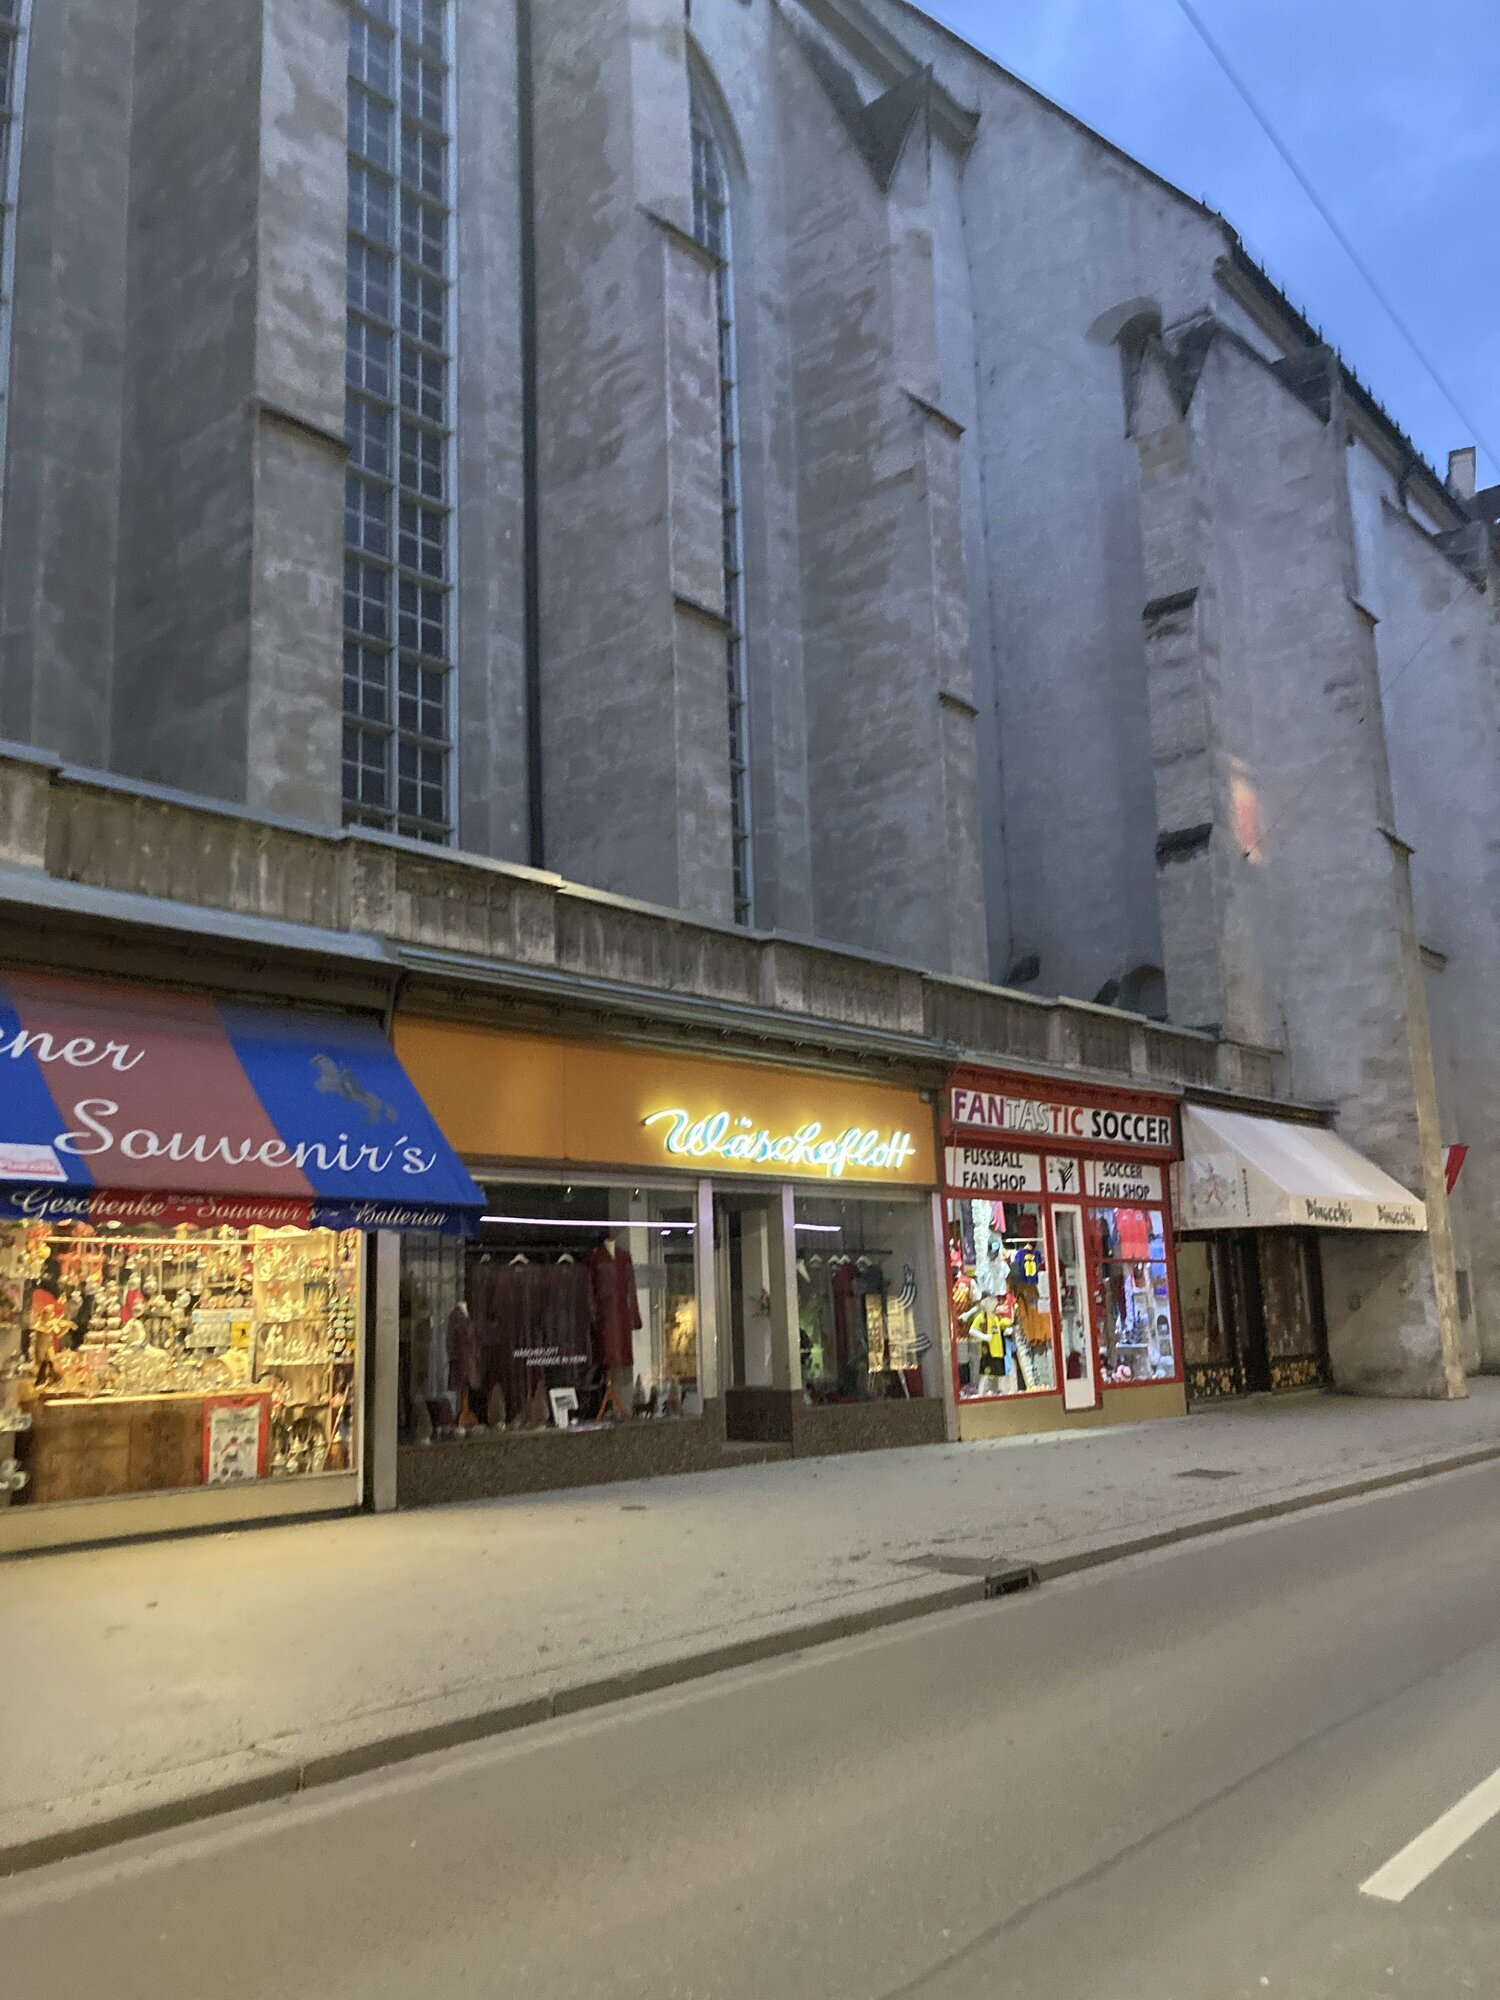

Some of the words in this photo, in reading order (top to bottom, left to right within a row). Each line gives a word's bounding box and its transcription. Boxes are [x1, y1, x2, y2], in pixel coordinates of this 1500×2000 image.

[0, 1028, 145, 1072] ner
[953, 1089, 1084, 1136] FANTASTIC
[1091, 1110, 1170, 1145] SOCCER
[963, 1148, 1023, 1169] FUSSBALL
[962, 1170, 989, 1189] FAN
[992, 1173, 1026, 1191] SHOP
[1103, 1162, 1143, 1180] SOCCER
[1098, 1182, 1120, 1198] FAN
[1122, 1183, 1150, 1200] SHOP
[11, 1188, 169, 1219] Geschenke
